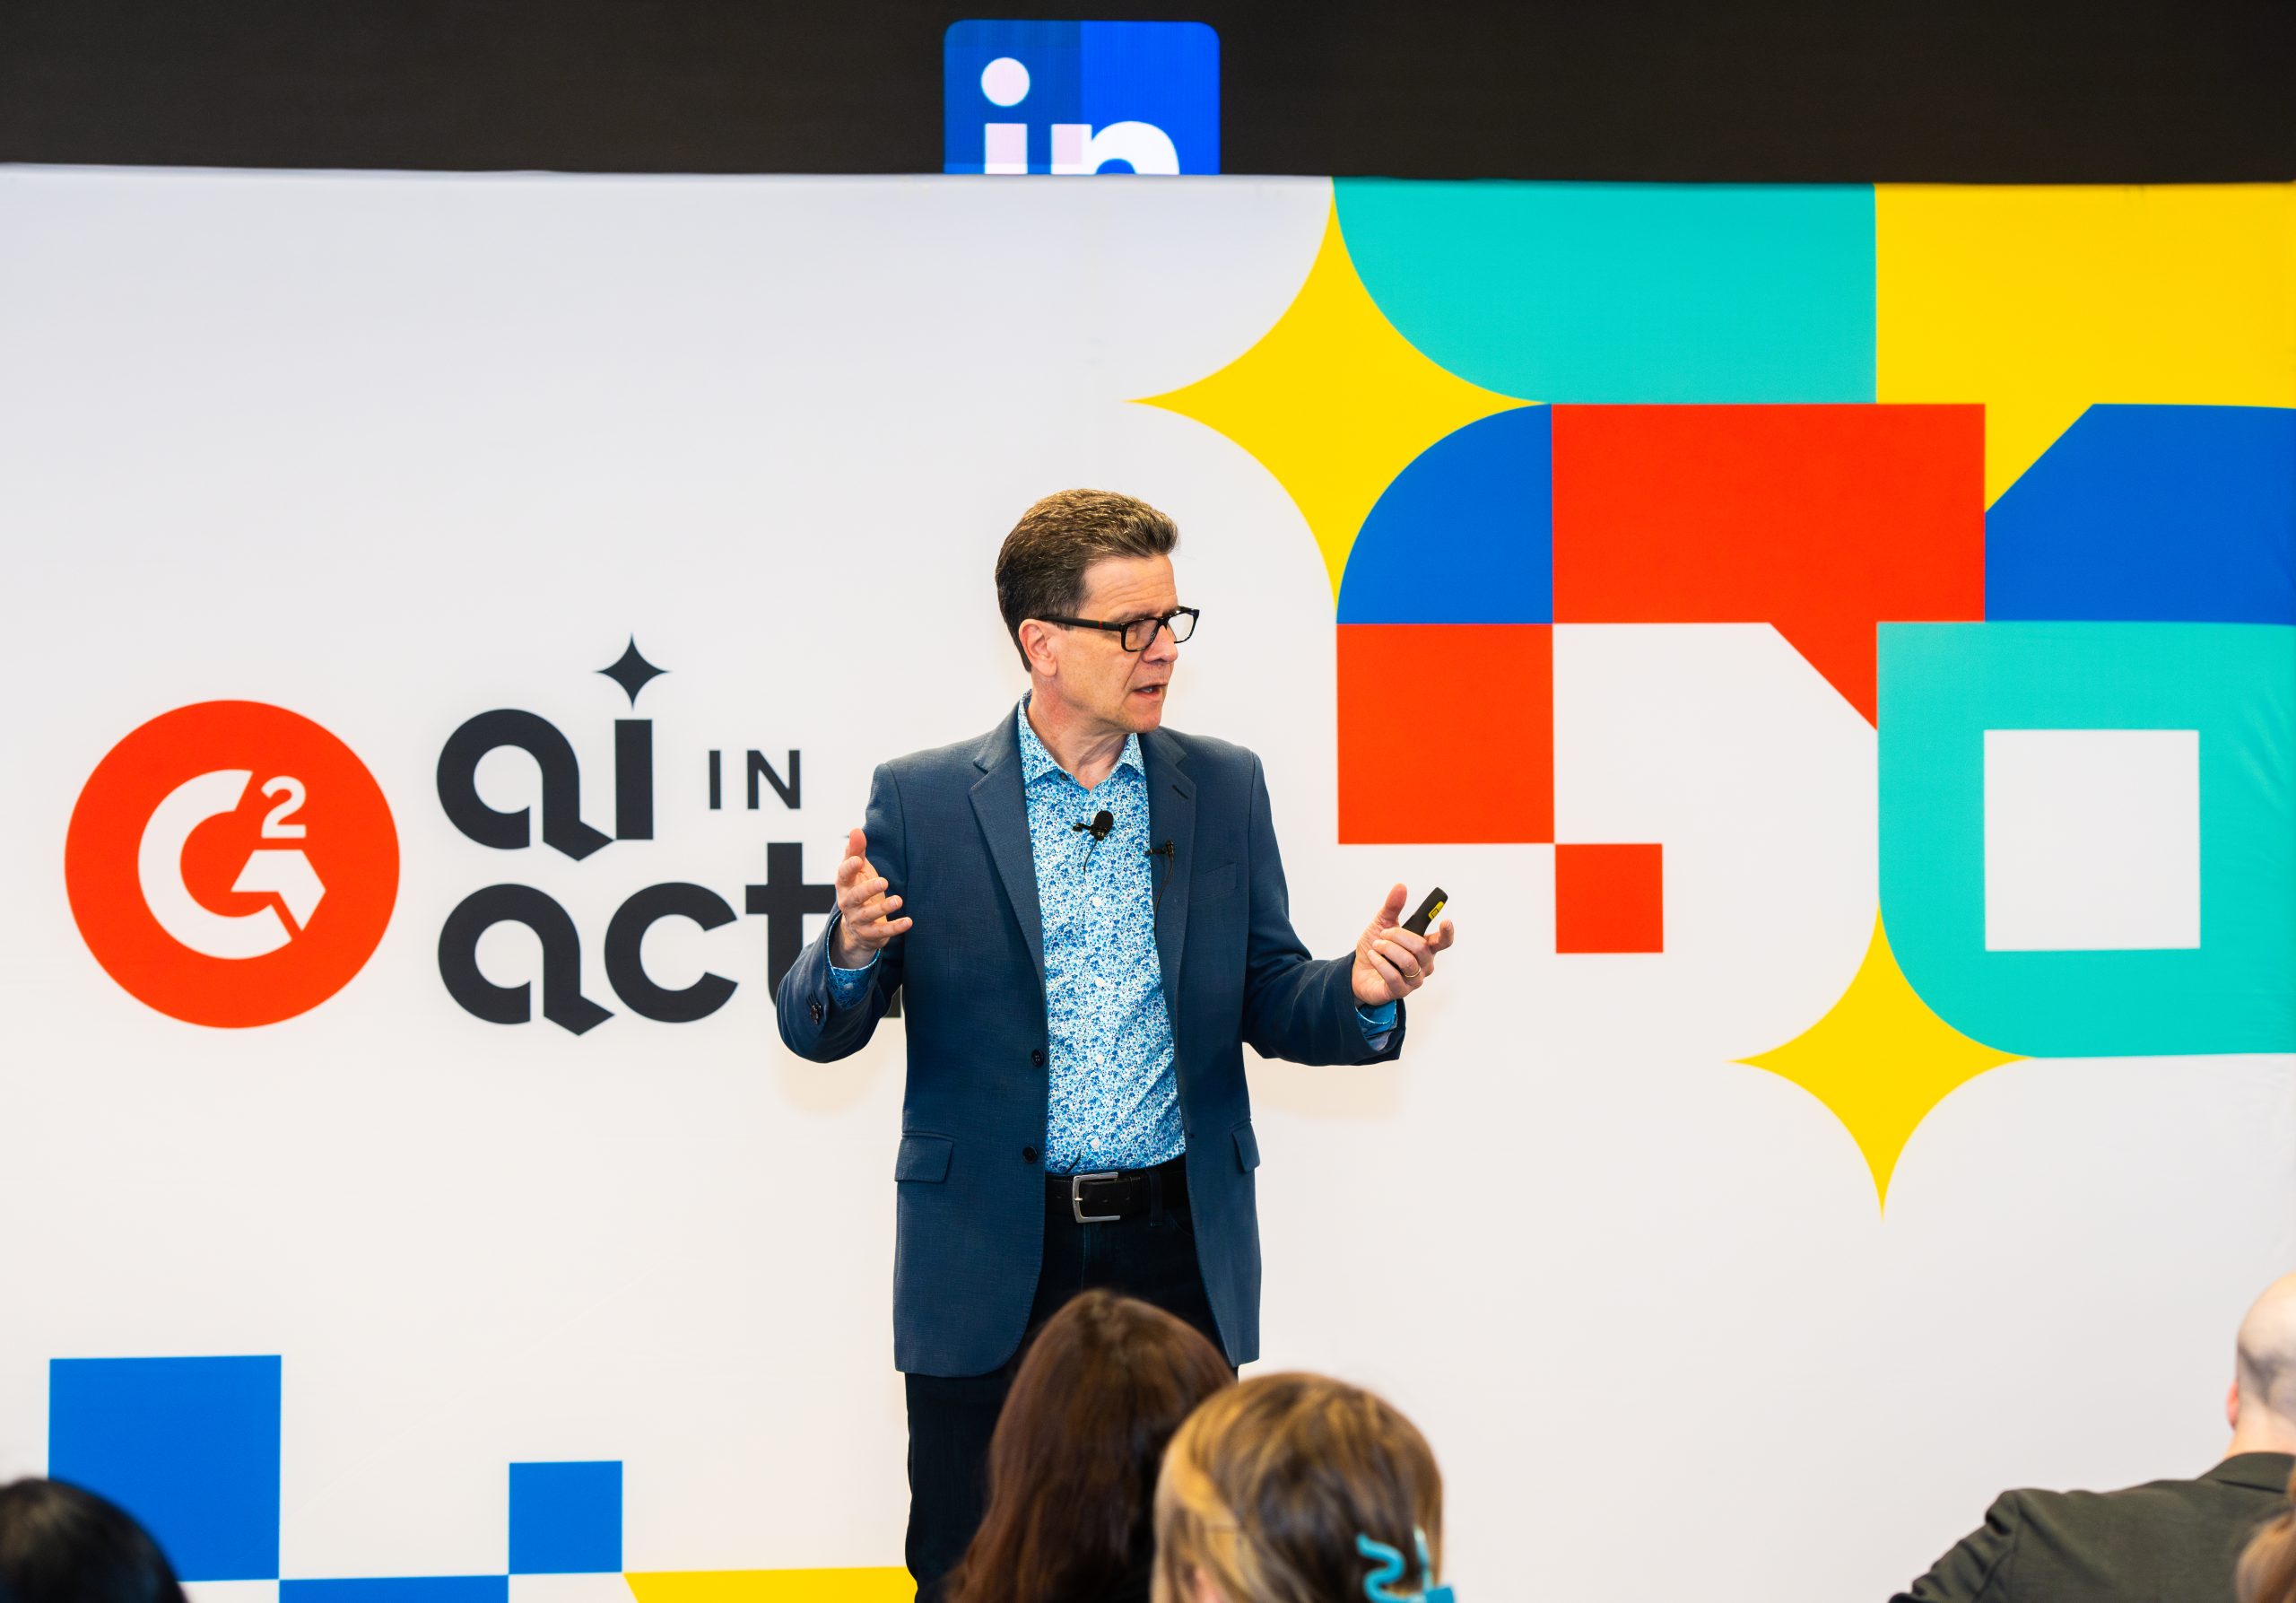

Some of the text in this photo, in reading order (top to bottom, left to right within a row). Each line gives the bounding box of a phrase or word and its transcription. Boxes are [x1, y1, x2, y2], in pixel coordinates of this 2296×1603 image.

[437, 632, 802, 862] ai IN
[438, 841, 901, 1037] act
